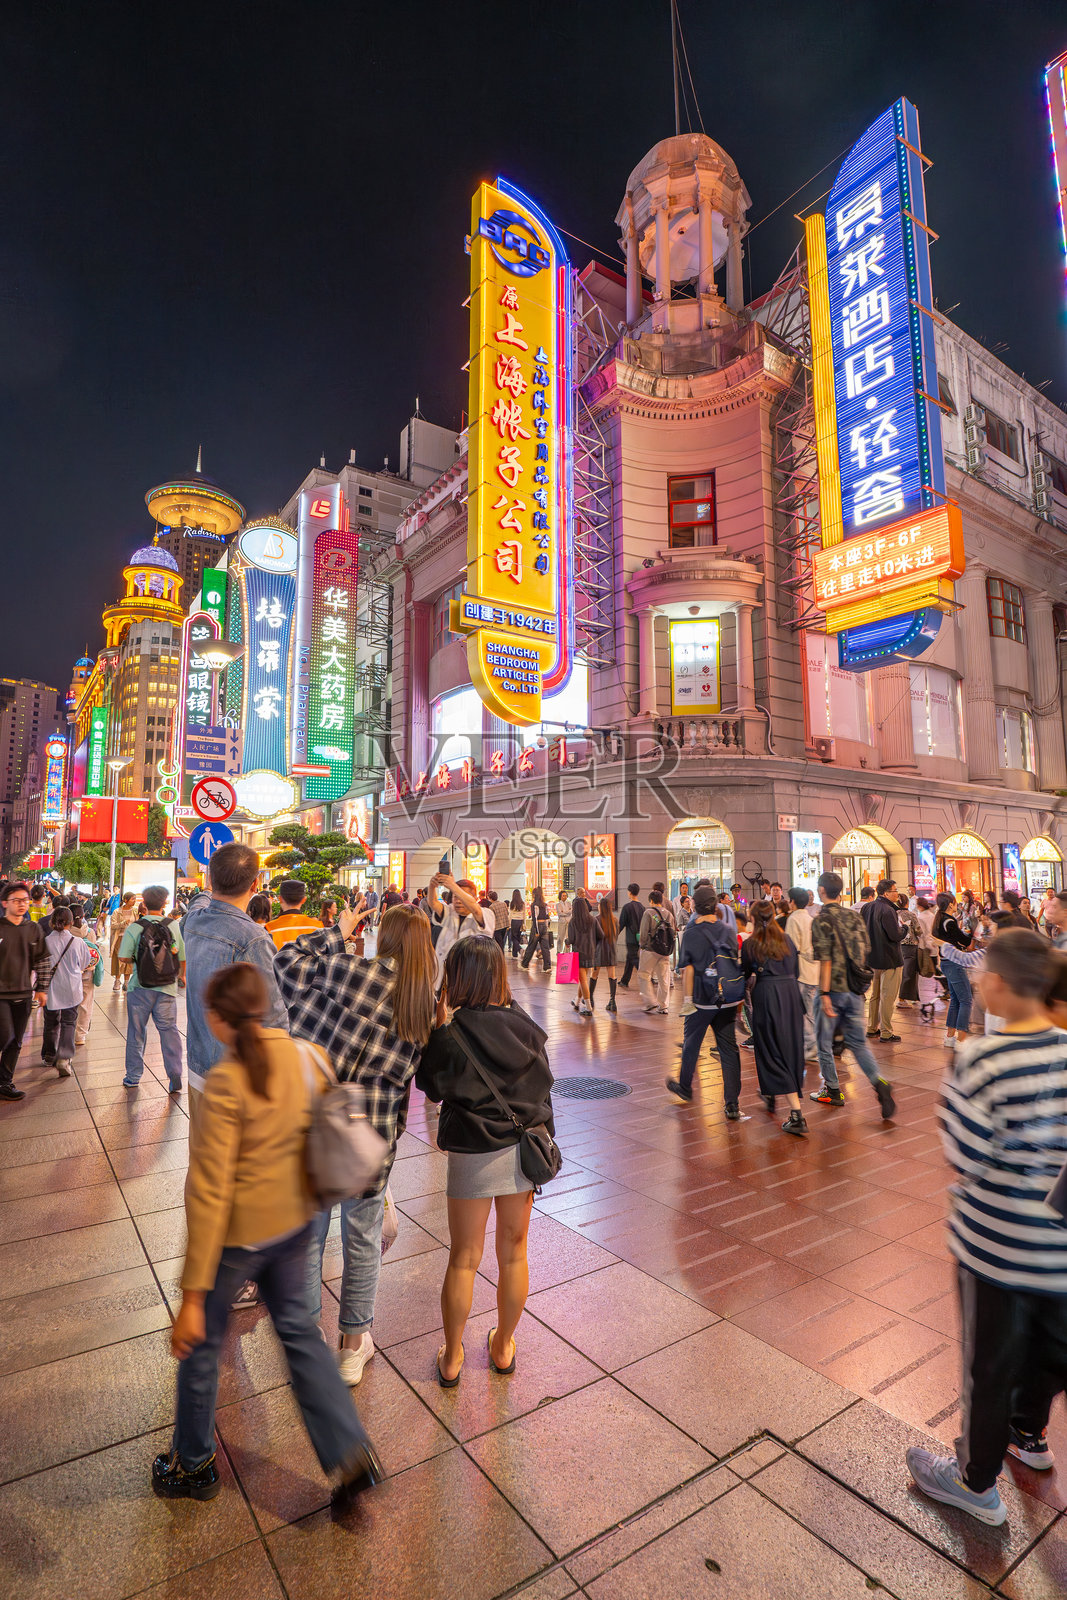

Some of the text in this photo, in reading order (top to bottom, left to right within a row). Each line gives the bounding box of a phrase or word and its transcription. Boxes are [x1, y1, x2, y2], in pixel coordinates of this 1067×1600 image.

[479, 216, 550, 269] BAC
[464, 602, 556, 634] 创建于1942年
[319, 586, 349, 732] 华美大药房
[487, 642, 540, 660] SHANGHAI
[493, 667, 540, 683] ARTICLES
[296, 684, 309, 755] Pharmacy
[192, 744, 219, 752] 人民广场
